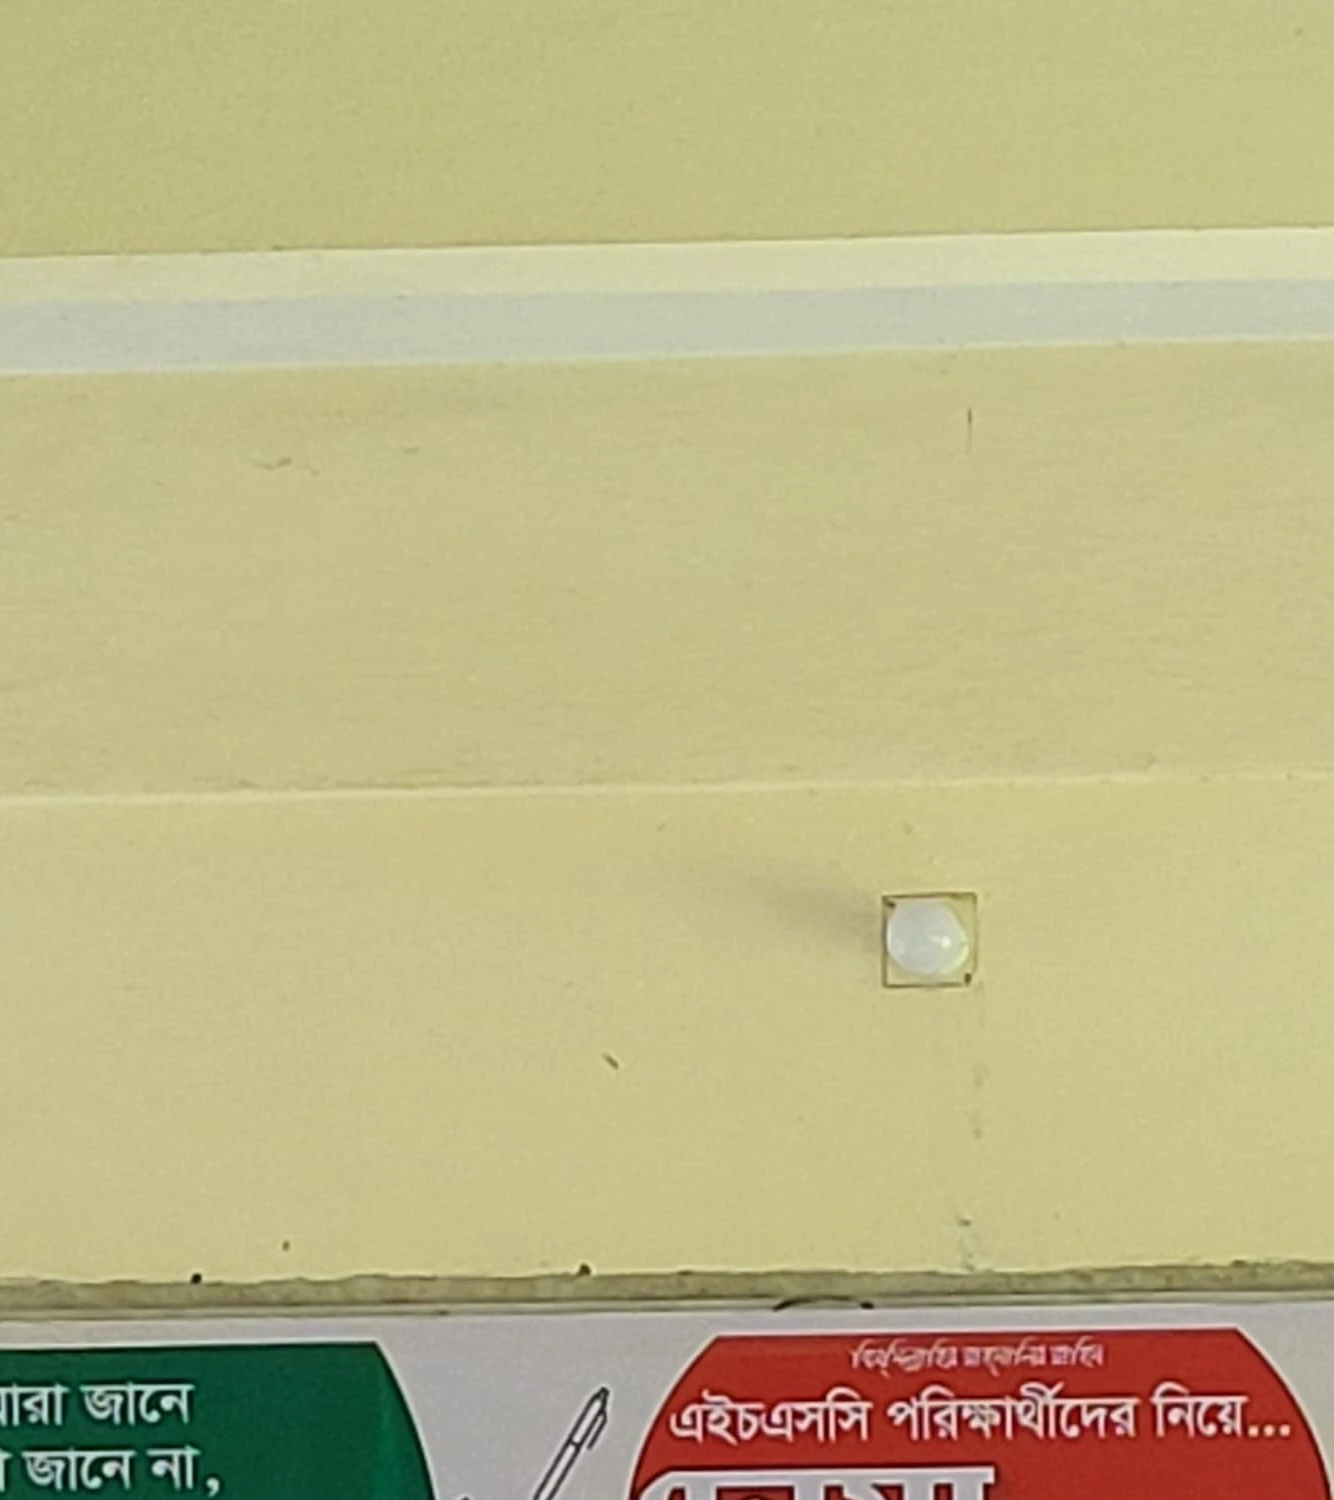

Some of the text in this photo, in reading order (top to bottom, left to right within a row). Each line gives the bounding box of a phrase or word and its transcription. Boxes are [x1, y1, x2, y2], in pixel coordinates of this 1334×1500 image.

[80, 1382, 193, 1425] জানে
[670, 1388, 873, 1443] এইচএসসি
[886, 1382, 1139, 1440] পরিক্ষার্থীদের
[26, 1448, 135, 1491] জানে
